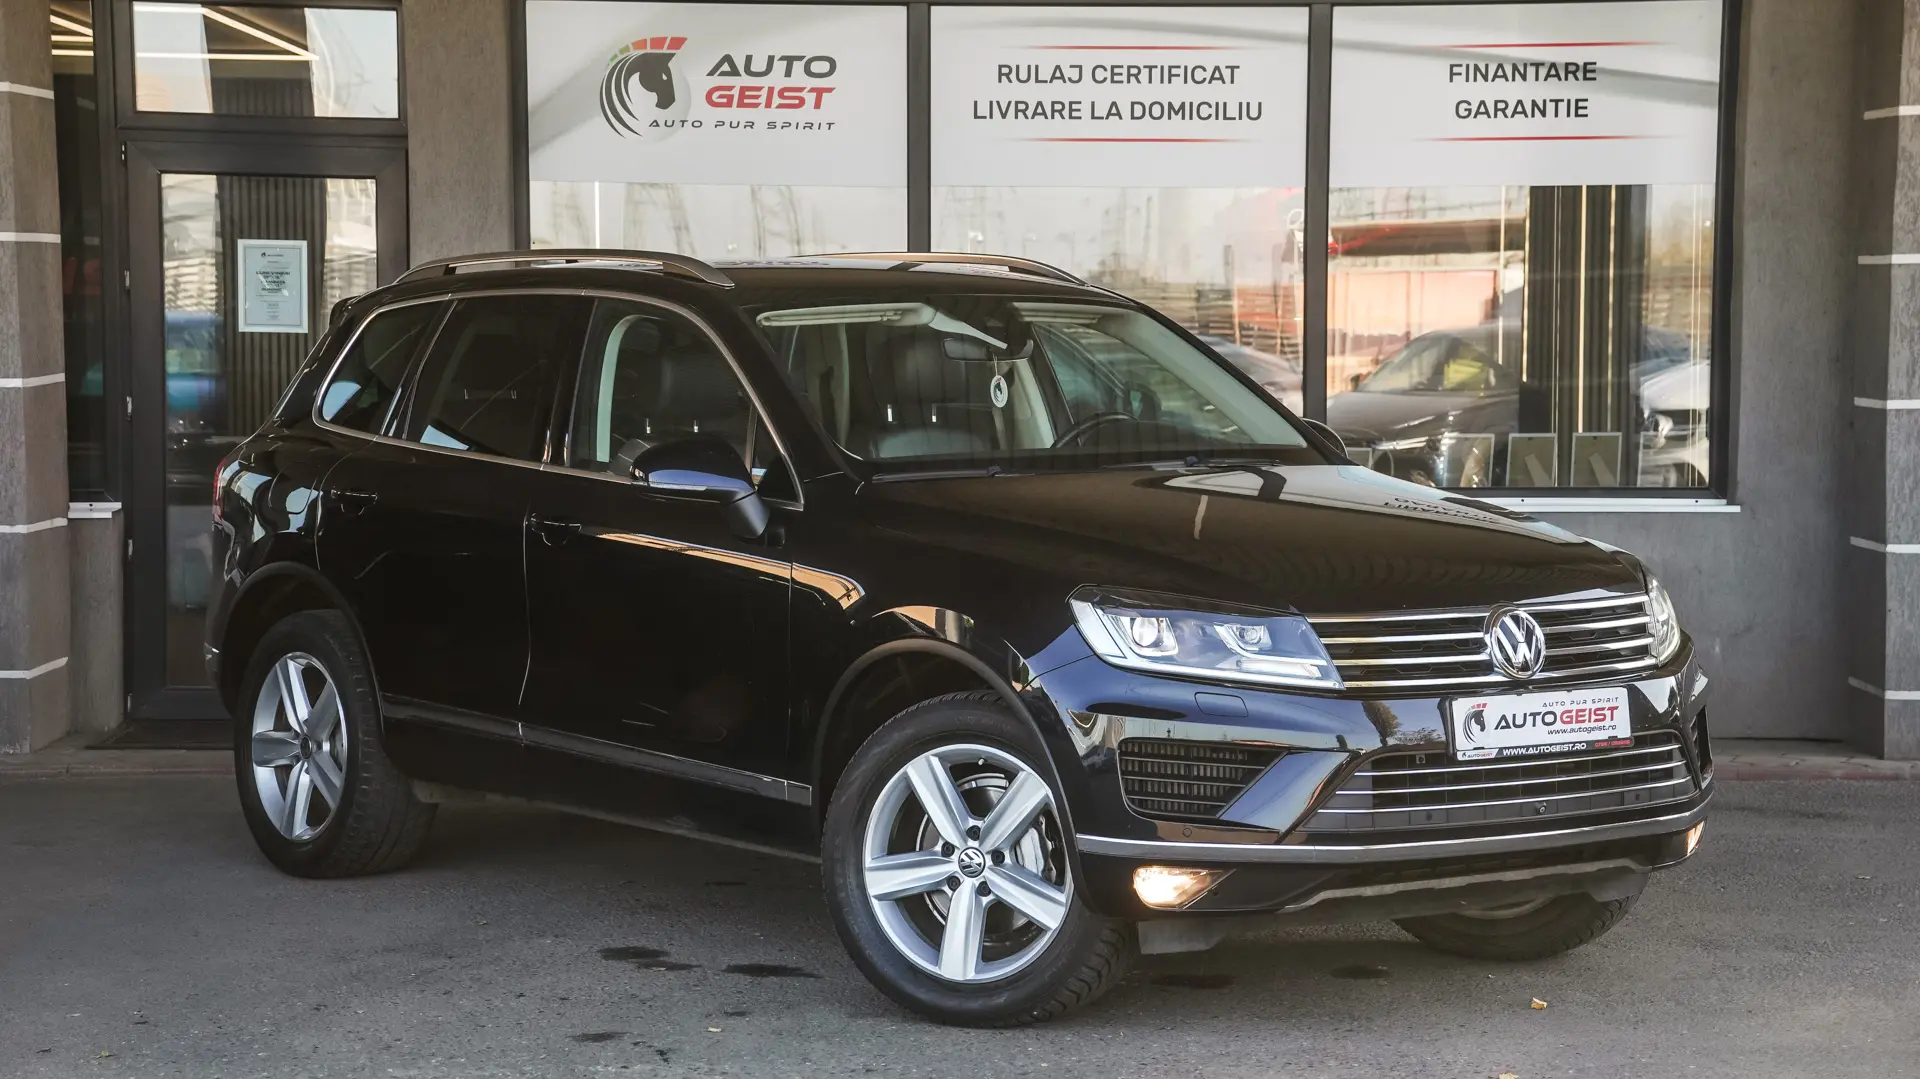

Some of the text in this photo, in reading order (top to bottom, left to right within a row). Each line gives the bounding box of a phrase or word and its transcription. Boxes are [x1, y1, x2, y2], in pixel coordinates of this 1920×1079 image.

[706, 53, 837, 79] AUTO
[997, 64, 1240, 85] RULAJ CERTIFICAT
[1449, 61, 1597, 83] FINANTARE
[705, 85, 836, 110] GEIST
[973, 100, 1263, 121] LIVRARE LA DOMICILIU
[1455, 98, 1589, 119] GARANTIE
[648, 119, 836, 131] AUTO PUR SPIRIT
[1542, 700, 1566, 708] AUTO
[1591, 696, 1619, 704] SPIRIT
[1547, 724, 1617, 735] www.autogeist.ro
[1503, 743, 1587, 756] WWW.AUTOGEIST.RO
